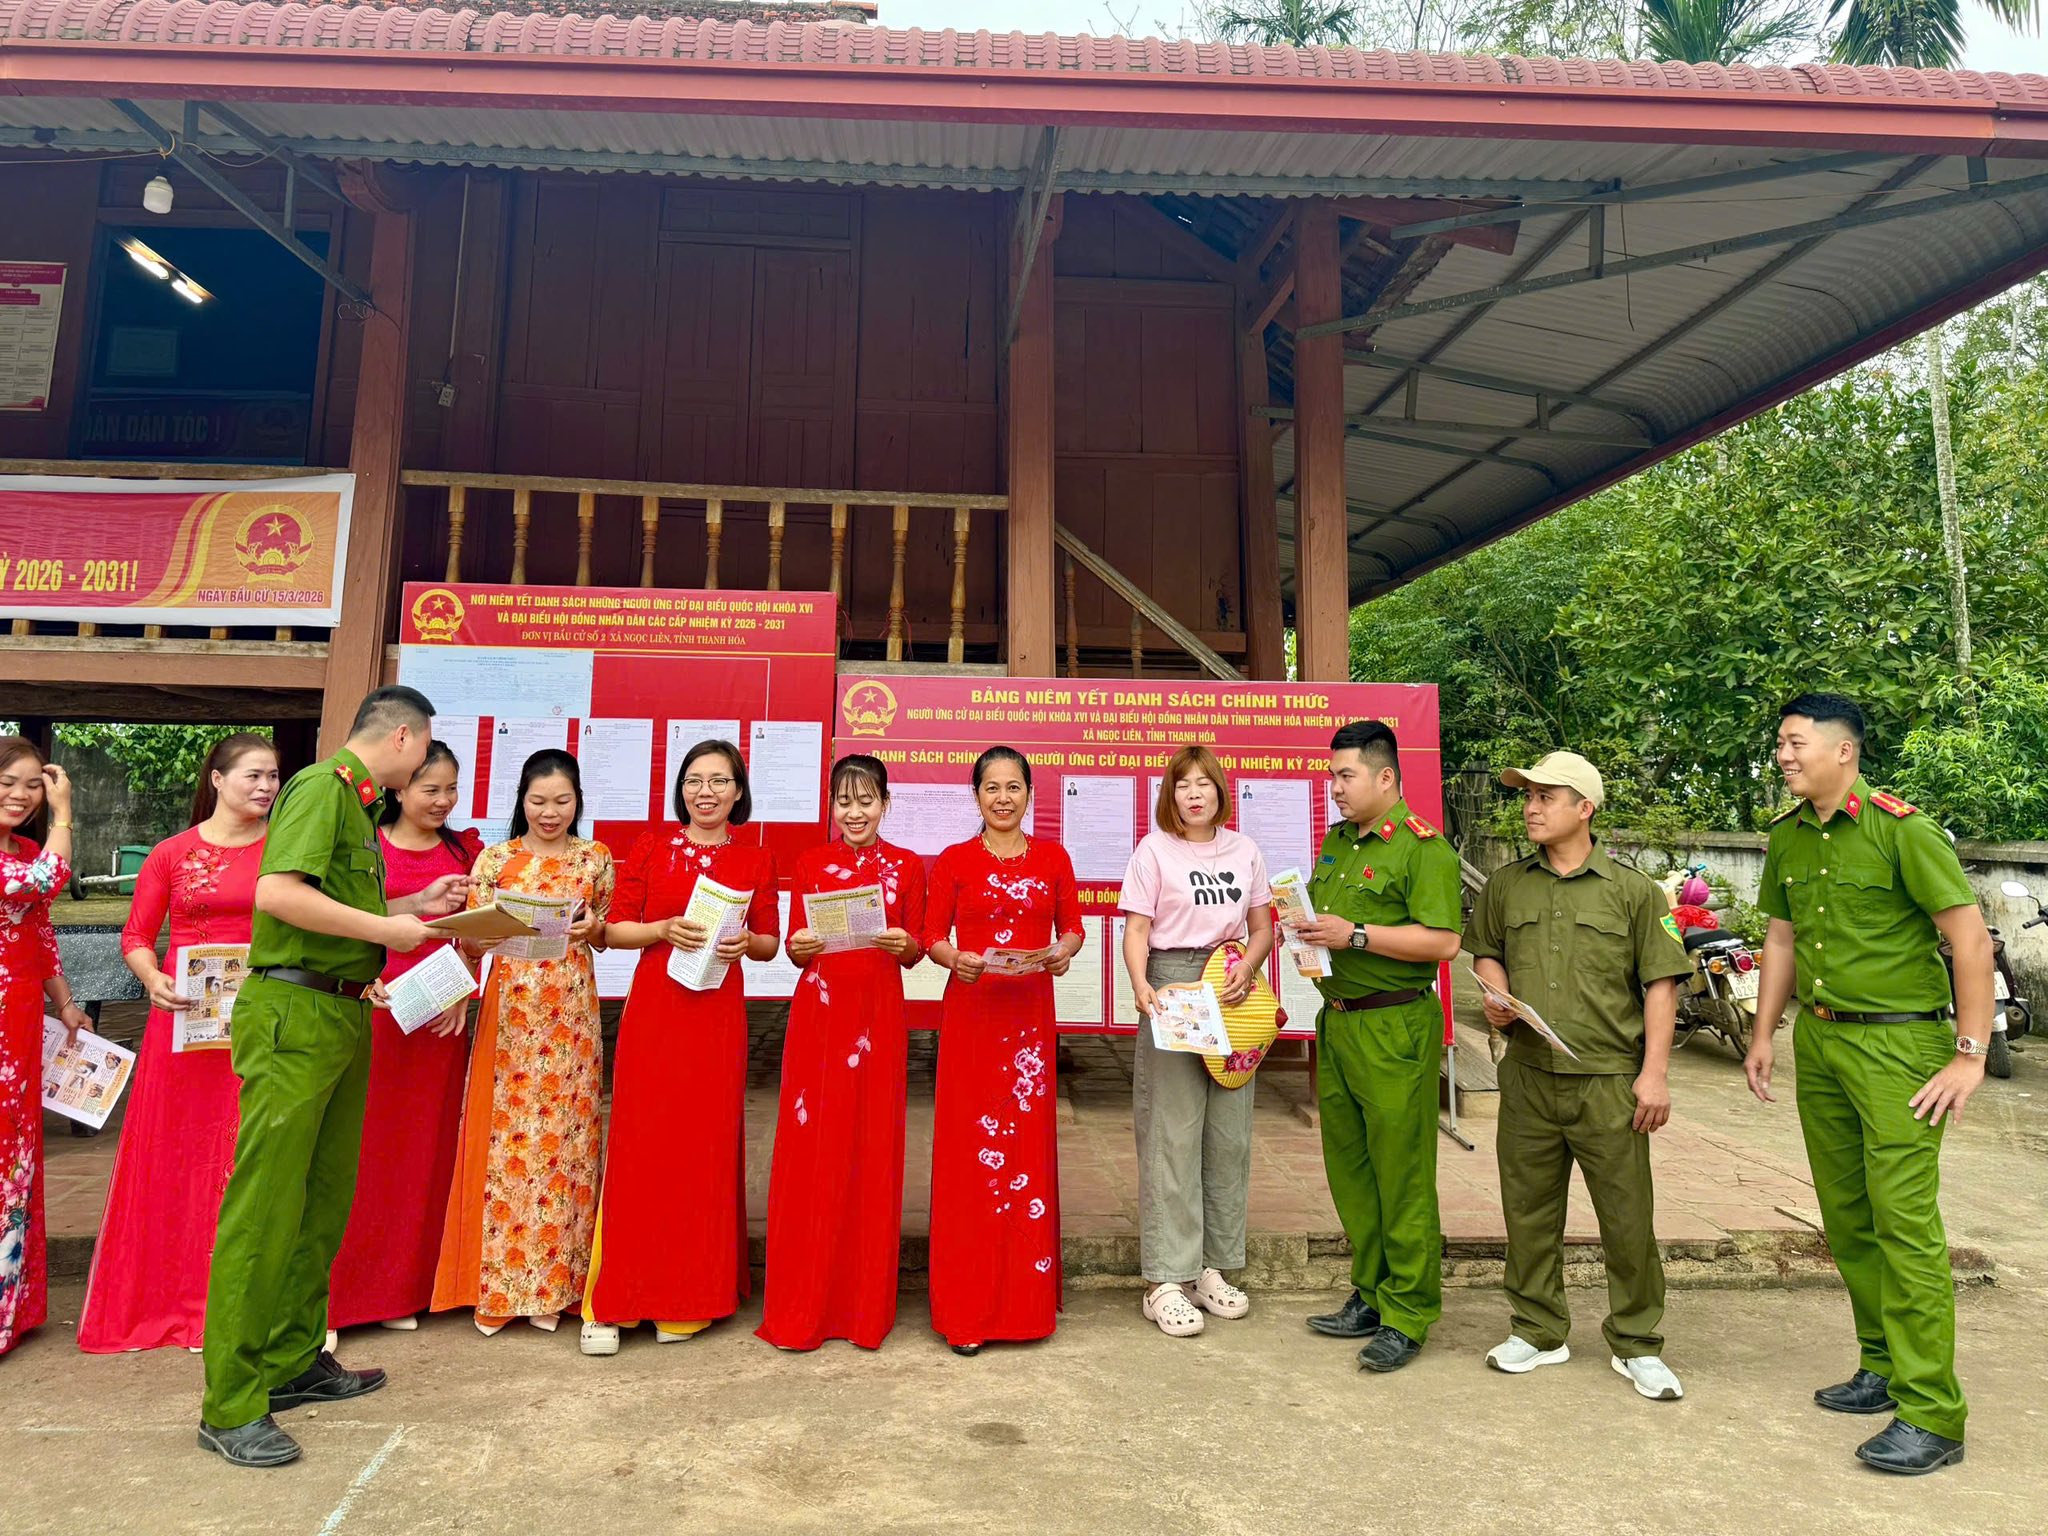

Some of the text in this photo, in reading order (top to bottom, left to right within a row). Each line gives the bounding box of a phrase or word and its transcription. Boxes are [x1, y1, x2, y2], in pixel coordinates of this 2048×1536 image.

[14, 559, 64, 591] 2026
[82, 559, 138, 592] 2031!
[198, 587, 226, 602] NGÀY
[272, 590, 324, 603] 15/3/2026
[516, 592, 533, 606] YẾT
[535, 596, 560, 607] DANH
[562, 594, 586, 608] SÁCH
[730, 598, 752, 613] QUỐC
[799, 603, 814, 614] XVI
[648, 614, 666, 627] CÁC
[668, 614, 686, 628] CẤP
[689, 616, 718, 630] NHIỆM
[734, 618, 756, 629] 2026
[764, 619, 785, 630] 2031
[696, 636, 726, 645] THANH
[972, 686, 1329, 709] BẢNG NIÊM YẾT DANH SÁCH CHÍNH THỨC
[1007, 708, 1030, 722] QUỐC
[1032, 711, 1046, 724] HỘI
[1074, 713, 1088, 723] XVI
[1142, 712, 1156, 726] HỘI
[1254, 716, 1281, 726] THANH
[1304, 714, 1332, 728] NHIỆM
[1097, 730, 1120, 742] NGỌC
[1168, 731, 1196, 742] THANH
[1199, 729, 1216, 742] HÓA
[910, 749, 944, 763] SÁCH
[948, 750, 981, 764] CHÍN
[1069, 751, 1095, 766] ỨNG
[1099, 751, 1117, 766] CỬ
[1120, 754, 1140, 769] ĐẠI
[1241, 755, 1282, 772] NHIỆM
[1287, 755, 1303, 770] KỲ
[1307, 758, 1330, 771] 202
[1078, 888, 1094, 905] HỘI
